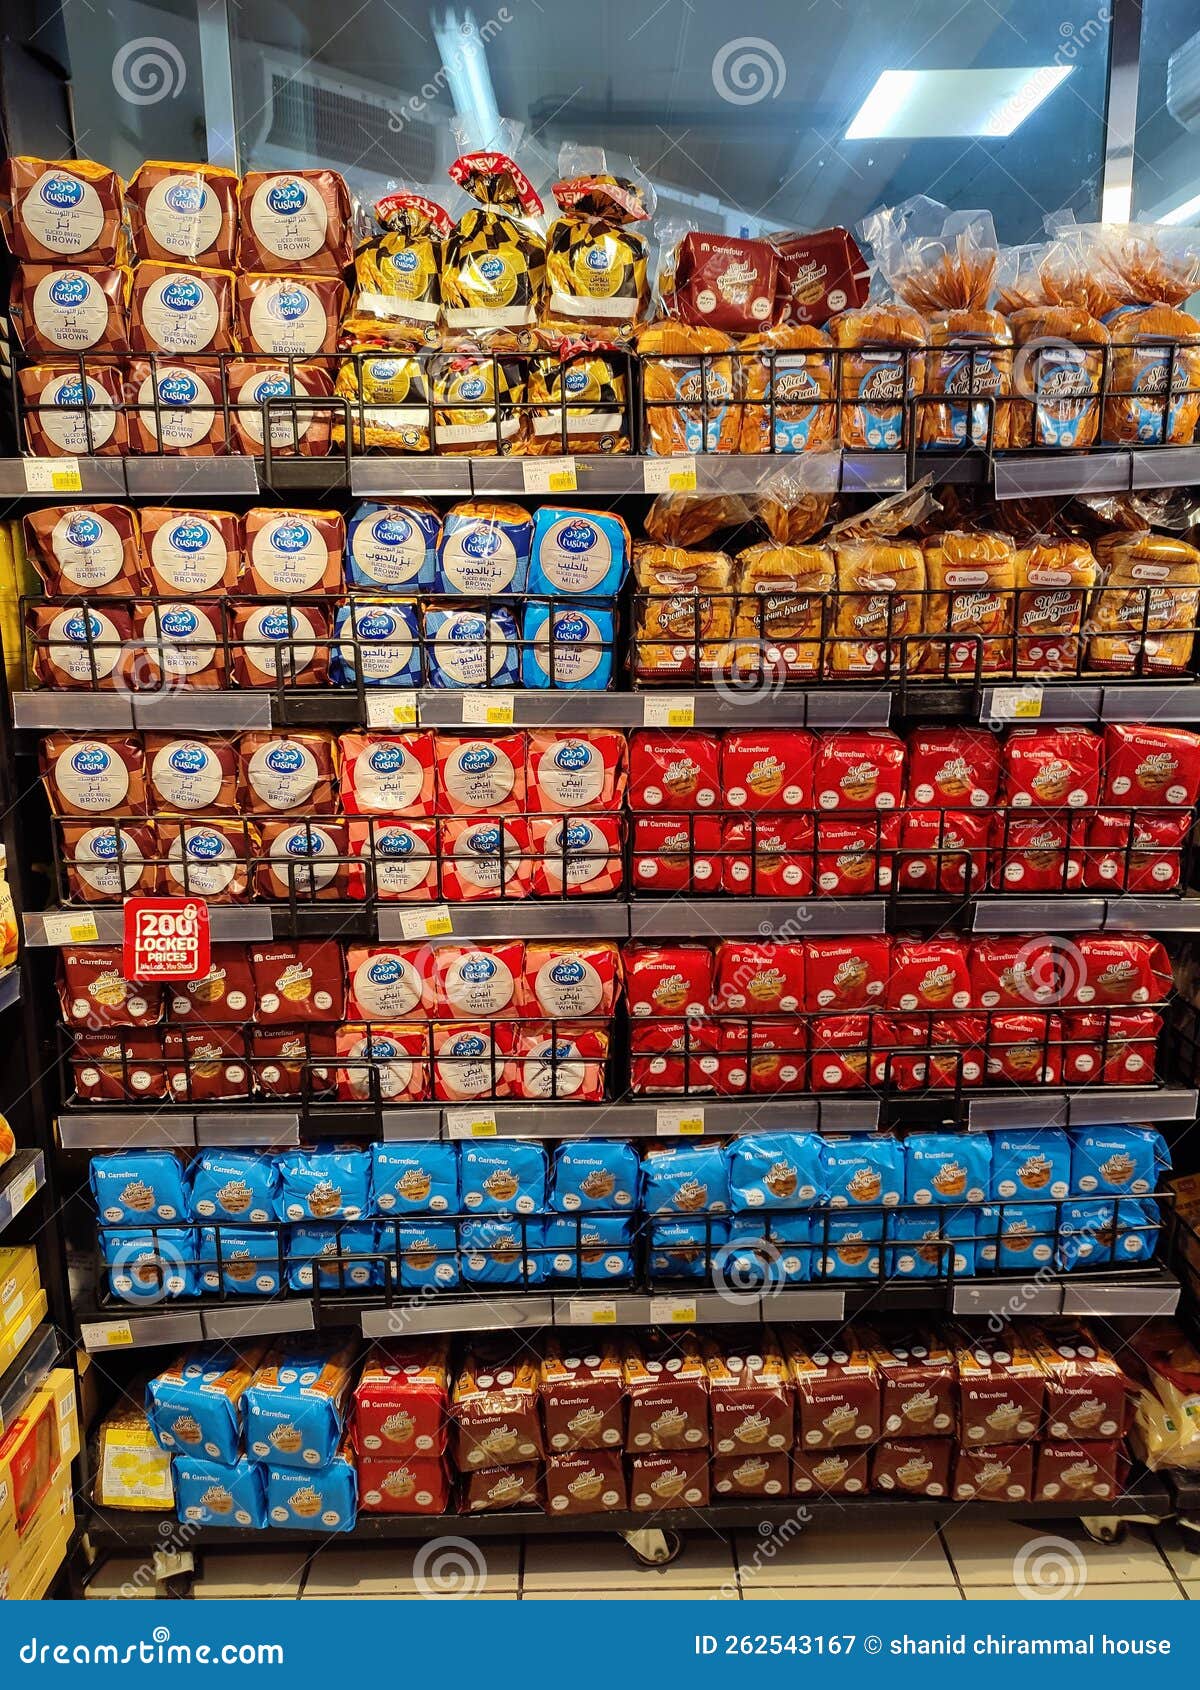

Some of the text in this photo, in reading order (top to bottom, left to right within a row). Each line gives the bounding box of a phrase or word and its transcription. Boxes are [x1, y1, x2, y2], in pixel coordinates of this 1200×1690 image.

[468, 157, 498, 171] NEW
[46, 235, 81, 246] BROWN
[276, 241, 311, 250] BROWN
[712, 245, 744, 257] Carrefour
[56, 332, 89, 341] BROWN
[164, 336, 197, 346] BROWN
[778, 370, 808, 391] Sliced
[373, 568, 399, 576] BROWN
[174, 575, 207, 584] BROWN
[274, 576, 306, 584] BROWN
[562, 577, 580, 585] MILK
[464, 580, 492, 588] BROWN
[556, 668, 574, 676] MILK
[1135, 736, 1168, 748] Carrefour
[654, 746, 686, 754] Carrefour
[737, 745, 769, 753] Carrefour
[930, 744, 960, 753] Carrefour
[834, 750, 865, 758] Carrefour
[1023, 750, 1055, 759] Carrefour
[170, 794, 201, 804] BROWN
[268, 794, 296, 802] BROWN
[559, 792, 585, 800] WHITE
[826, 830, 857, 838] Carrefour
[142, 914, 193, 936] 200
[135, 937, 198, 952] LOCKED
[147, 952, 187, 962] PRICES
[821, 948, 852, 958] Carrefour
[1092, 949, 1124, 957] Carrefour
[265, 953, 296, 962] Carrefour
[911, 955, 941, 964] Carrefour
[80, 958, 113, 966] Carrefour
[645, 963, 676, 971] Carrefour
[1004, 1024, 1034, 1033] Carrefour
[833, 1030, 863, 1038] Carrefour
[1095, 1141, 1126, 1149] Carrefour
[388, 1157, 419, 1165] Carrefour
[478, 1157, 508, 1165] Carrefour
[213, 1164, 244, 1176] Carrefour
[299, 1169, 328, 1177] Carrefour
[663, 1170, 693, 1179] Carrefour
[979, 1391, 1008, 1399] Carrefour
[1064, 1387, 1093, 1395] Carrefour
[560, 1398, 589, 1406] Carrefour
[644, 1398, 672, 1406] Carrefour
[815, 1394, 844, 1403] Carrefour
[726, 1403, 755, 1412] Carrefour
[261, 1410, 290, 1420] Carrefour
[471, 1417, 501, 1425] Carrefour
[561, 1460, 590, 1468] Carrefour
[643, 1459, 672, 1467] Carrefour
[192, 1473, 220, 1482] Carrefour
[282, 1474, 311, 1482] Carrefour
